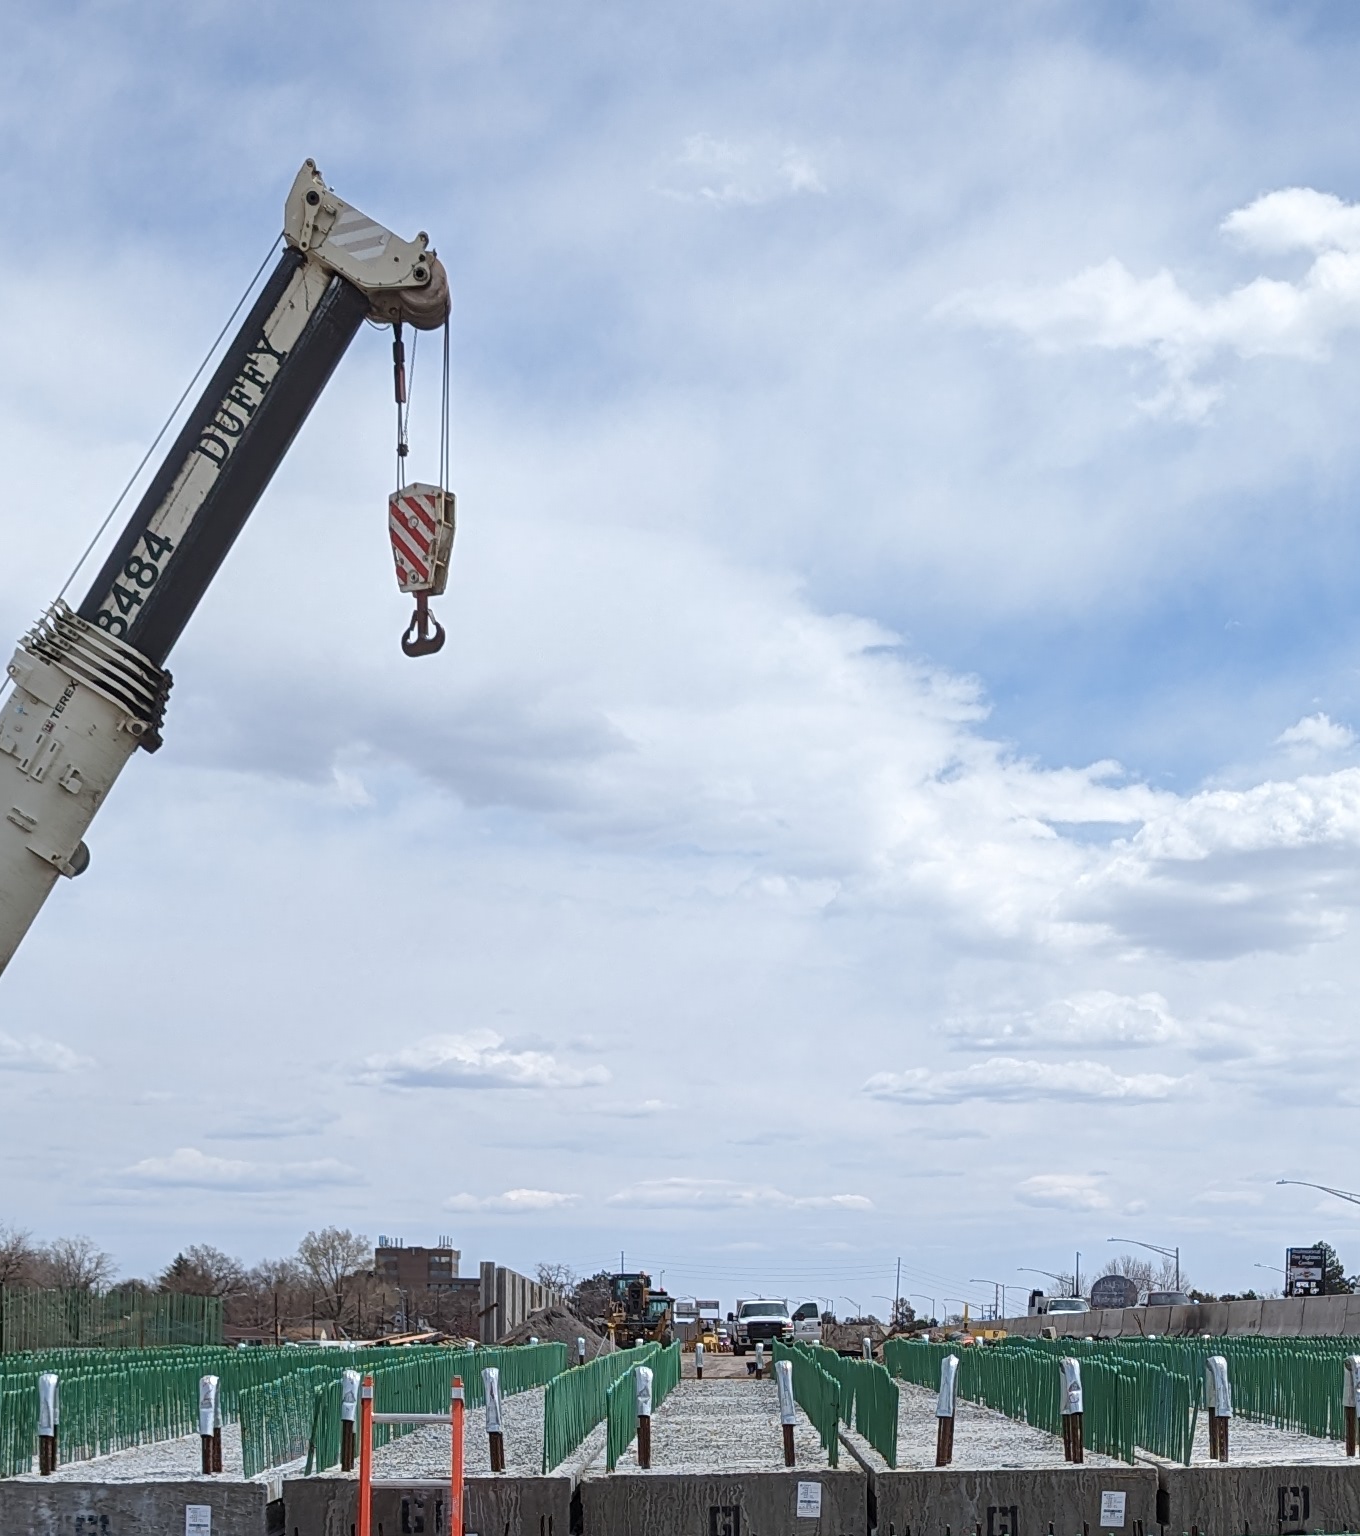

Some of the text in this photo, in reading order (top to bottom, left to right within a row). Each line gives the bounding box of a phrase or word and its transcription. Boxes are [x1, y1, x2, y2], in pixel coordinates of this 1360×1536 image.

[198, 329, 287, 469] DUFFY
[95, 529, 175, 638] 8484
[50, 680, 78, 718] TEREX
